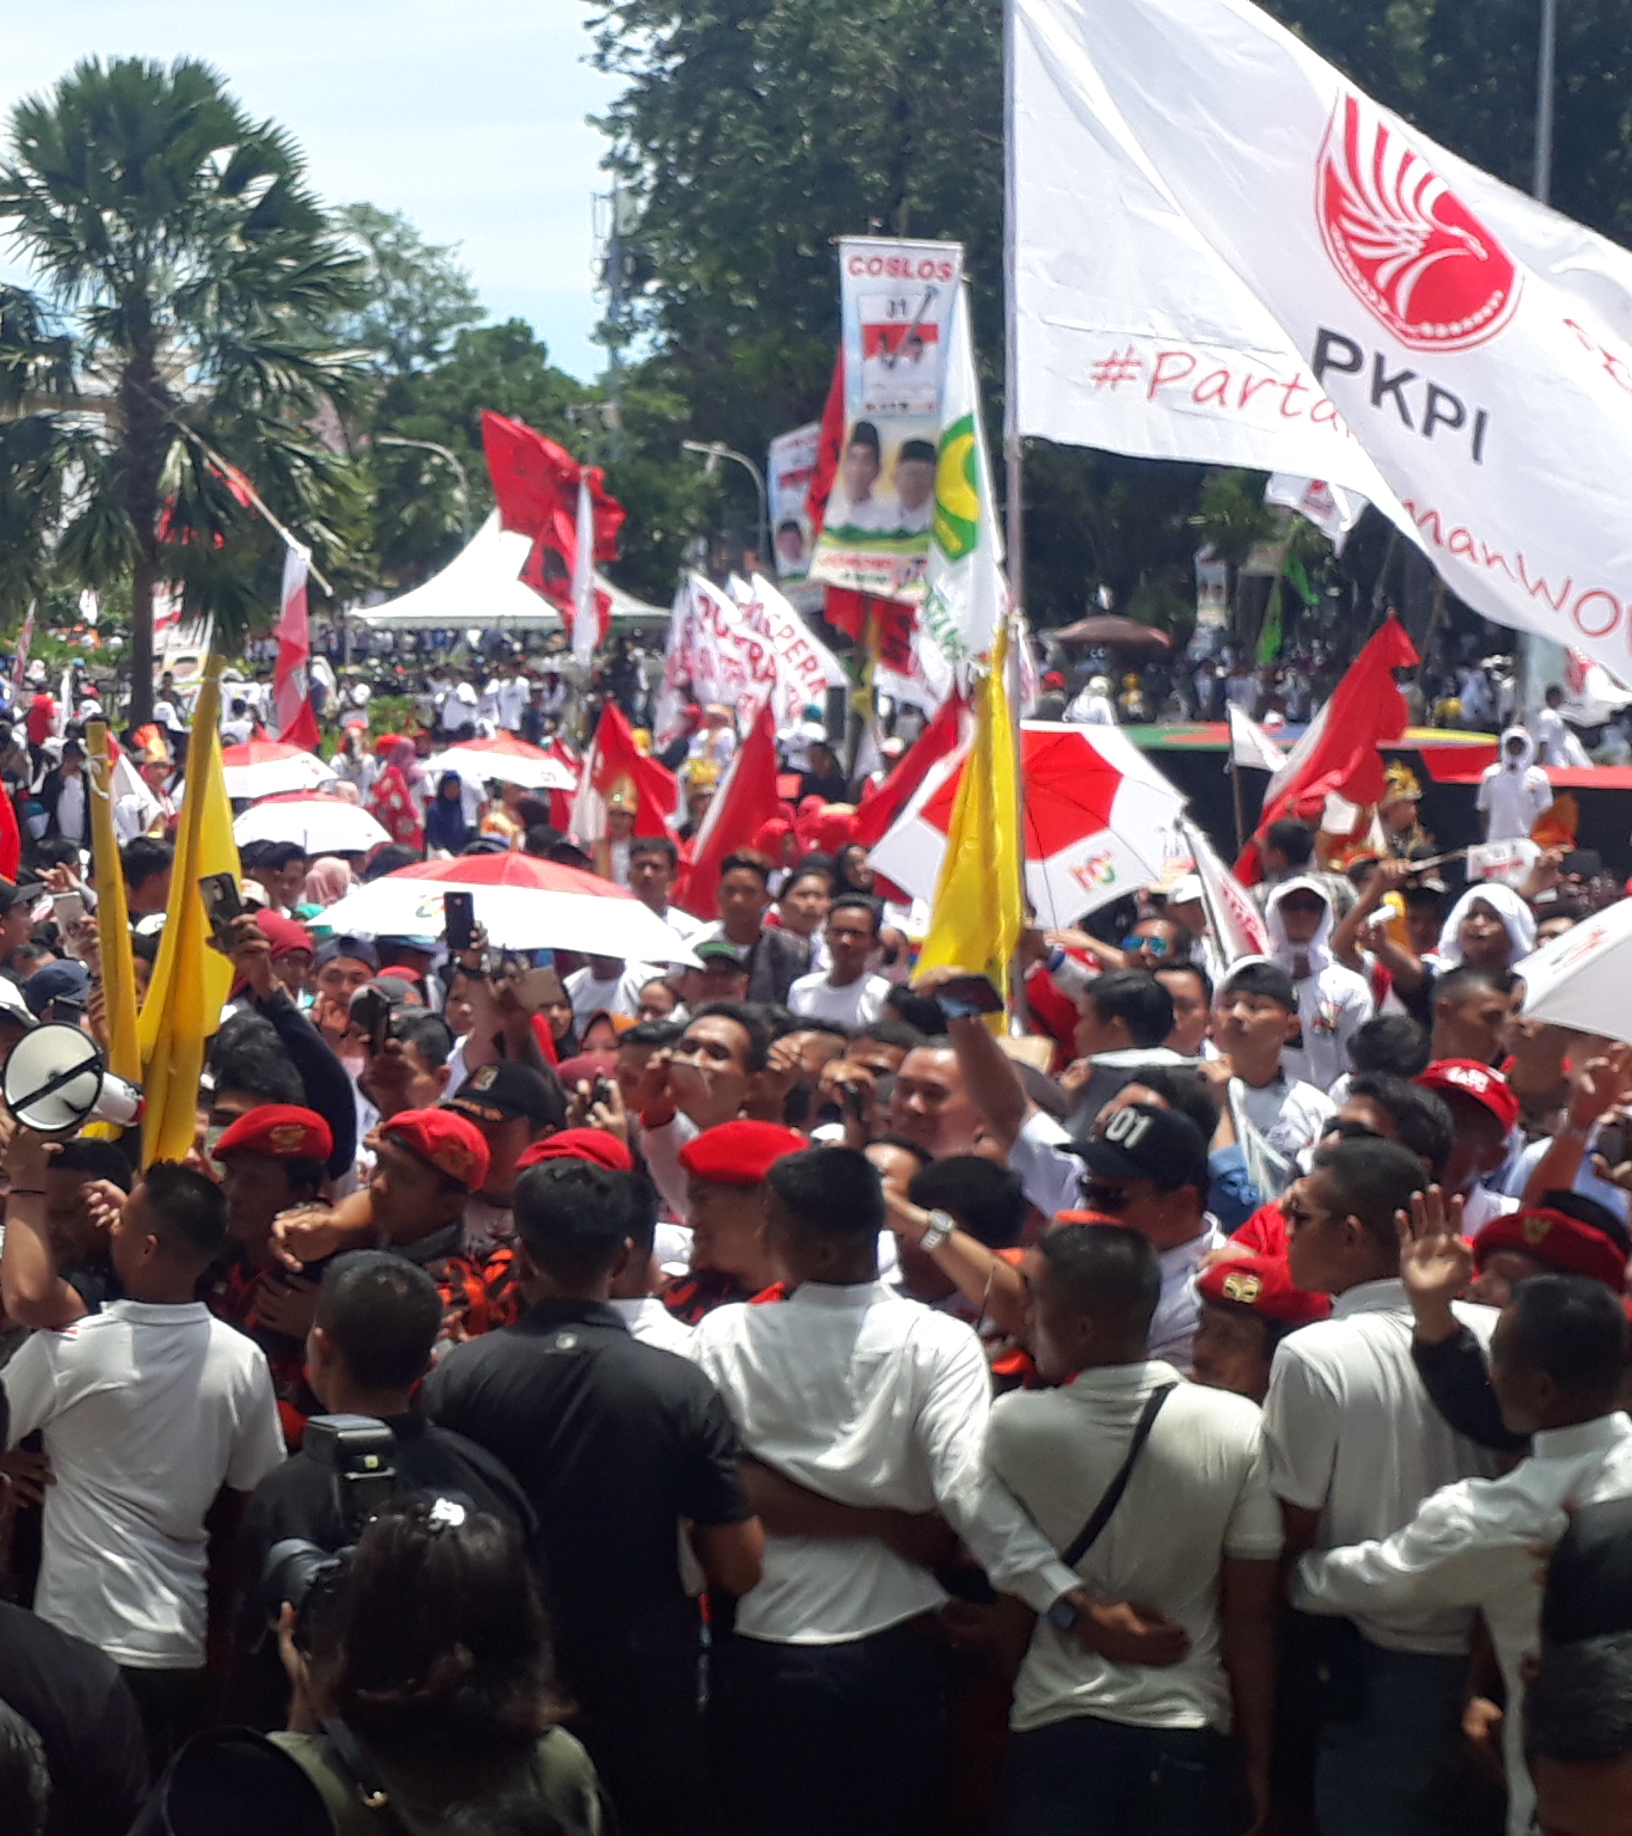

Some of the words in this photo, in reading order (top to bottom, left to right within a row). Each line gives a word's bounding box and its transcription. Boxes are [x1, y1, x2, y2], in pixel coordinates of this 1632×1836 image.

[1090, 344, 1353, 438] #Parta
[1313, 327, 1488, 463] PKPI
[1106, 1106, 1152, 1149] 01
